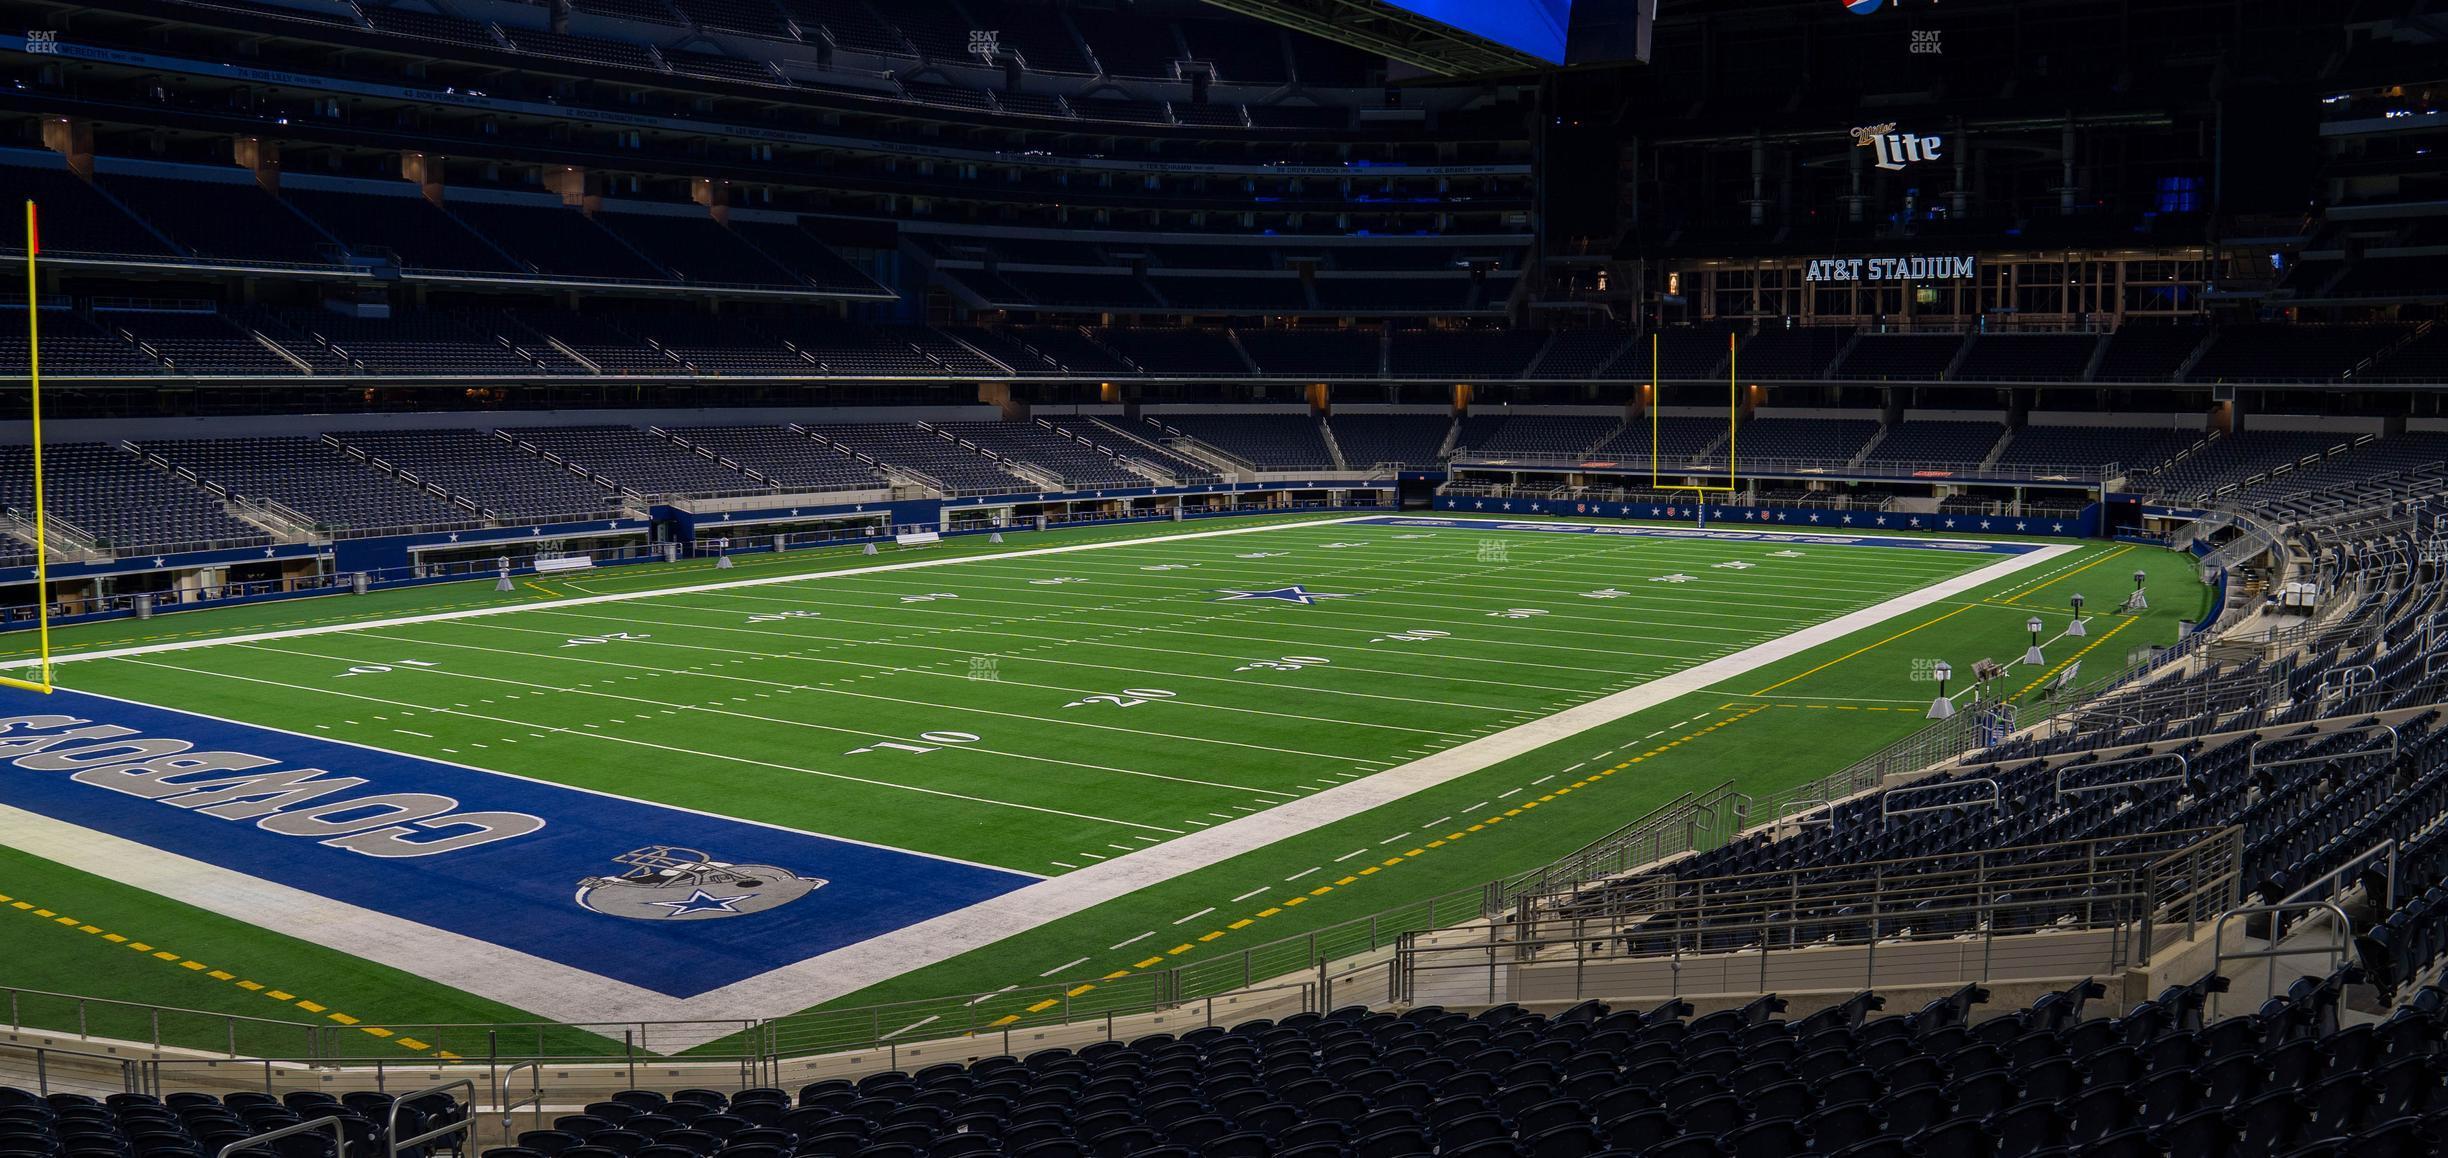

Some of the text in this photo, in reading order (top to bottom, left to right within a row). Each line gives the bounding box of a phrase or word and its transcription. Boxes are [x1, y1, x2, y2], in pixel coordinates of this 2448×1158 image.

[1870, 133, 1942, 171] Lite
[1806, 256, 1974, 282] AT&T STADIUM
[567, 631, 652, 645] 20
[1385, 629, 1452, 642] 40
[347, 659, 442, 674] 10
[1248, 655, 1332, 672] 30
[1081, 687, 1178, 709] 20
[870, 730, 982, 755] 10
